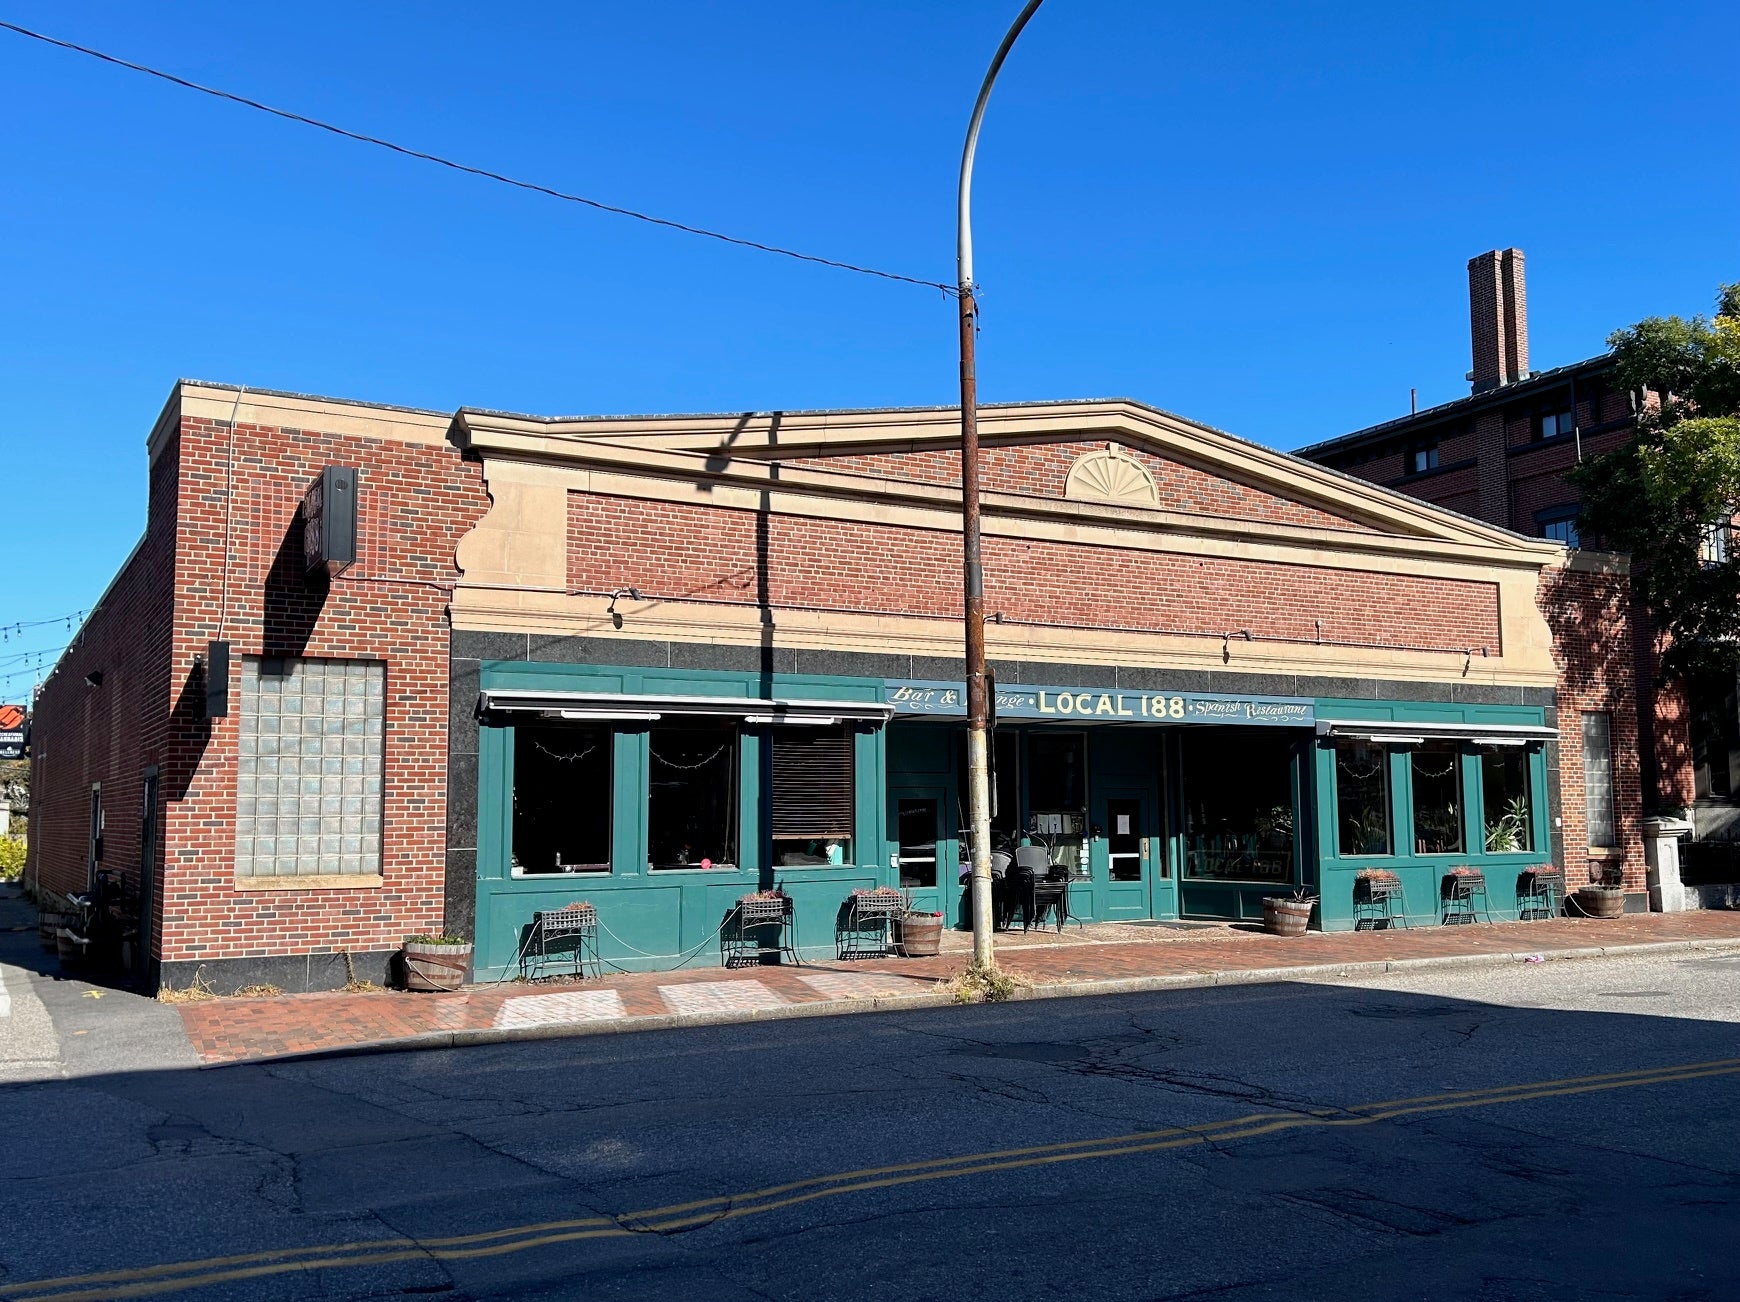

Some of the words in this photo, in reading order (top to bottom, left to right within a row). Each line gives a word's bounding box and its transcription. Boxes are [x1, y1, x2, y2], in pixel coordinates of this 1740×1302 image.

[890, 686, 934, 702] Bar
[941, 689, 957, 704] &
[1038, 690, 1134, 716] LOCAL
[1141, 694, 1185, 718] 188
[1195, 699, 1241, 716] Spanish
[1244, 702, 1307, 719] Restaurant
